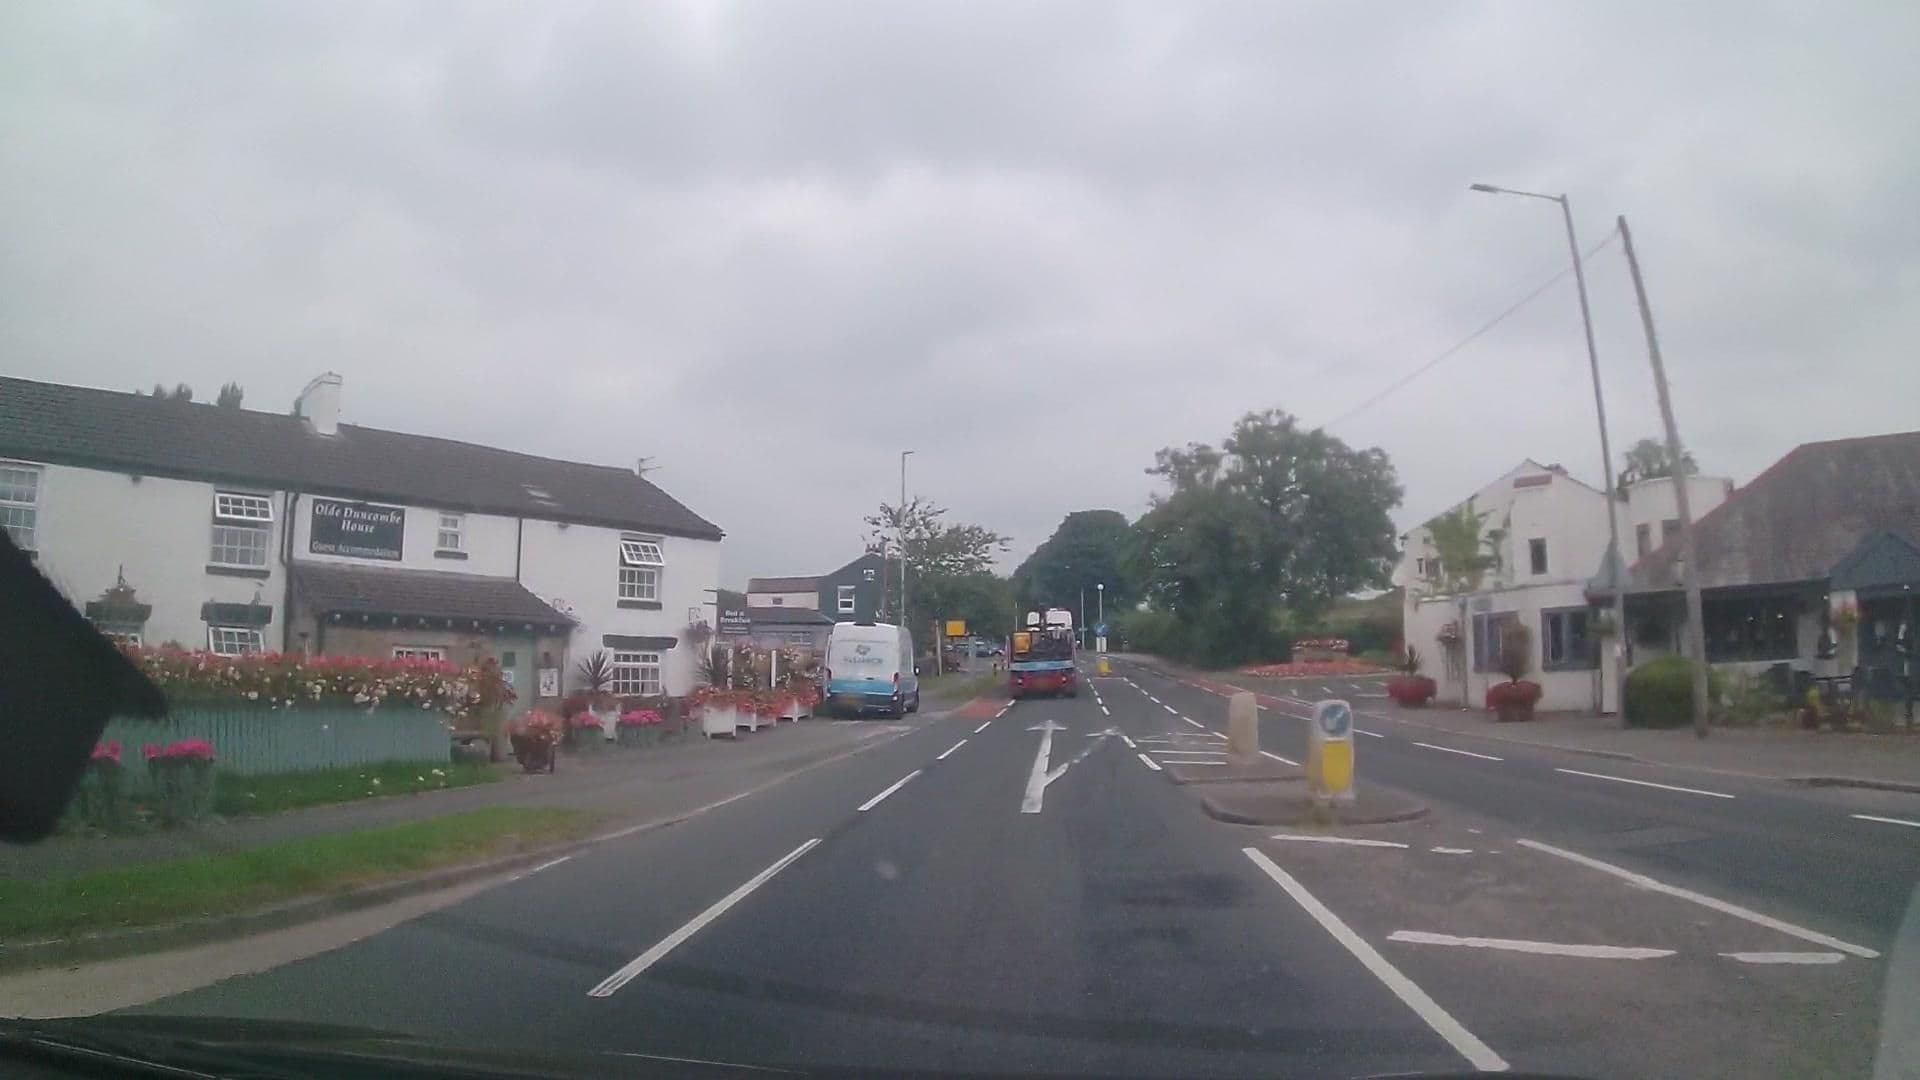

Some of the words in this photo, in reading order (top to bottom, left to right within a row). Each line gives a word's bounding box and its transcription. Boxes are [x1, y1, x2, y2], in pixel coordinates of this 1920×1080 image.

[315, 503, 341, 517] Olde
[344, 507, 401, 524] Duncombe
[341, 519, 375, 533] House
